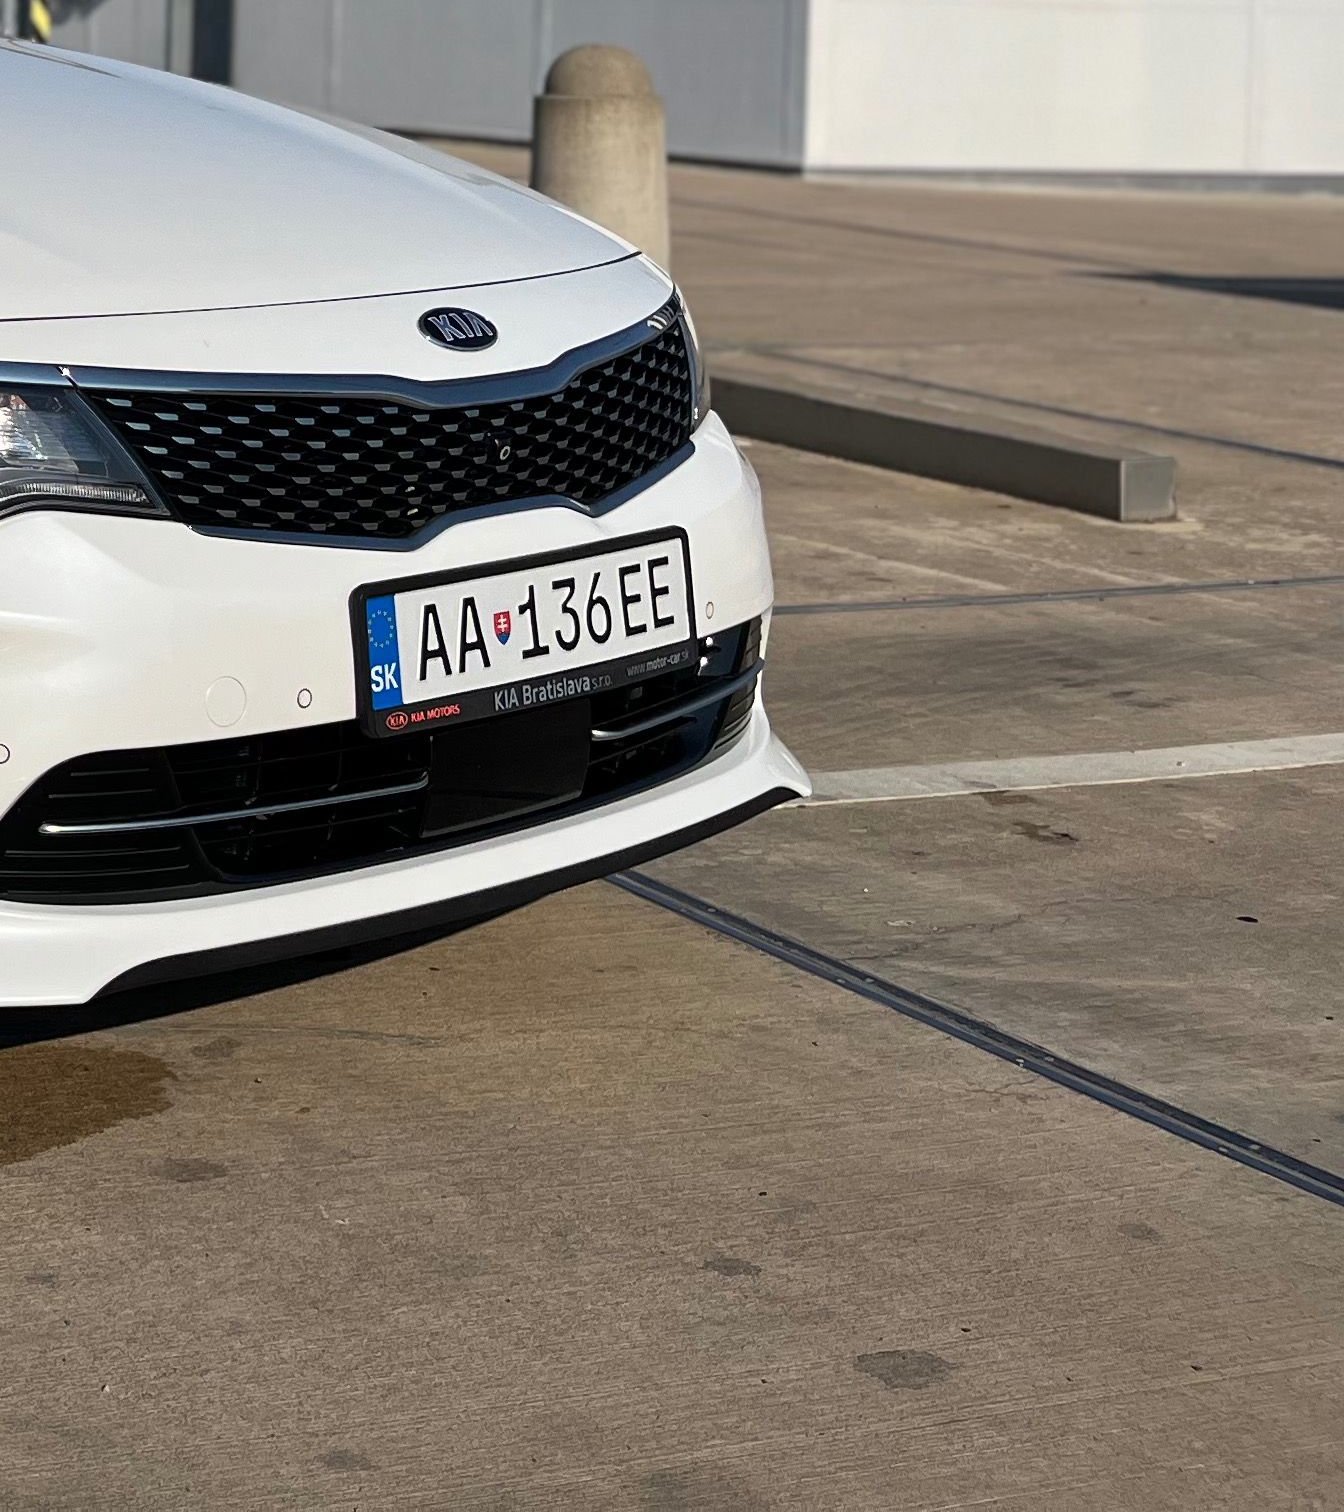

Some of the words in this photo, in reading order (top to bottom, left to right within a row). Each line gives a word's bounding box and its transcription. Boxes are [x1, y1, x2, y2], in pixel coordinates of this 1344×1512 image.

[426, 311, 495, 343] KIA
[419, 596, 491, 681] AA
[517, 556, 675, 660] 136EE
[370, 662, 399, 693] SK
[494, 690, 520, 712] KIA
[522, 676, 591, 705] Bratislava
[388, 714, 407, 727] KIA
[411, 712, 425, 723] KIA
[427, 704, 461, 719] MOTORS
